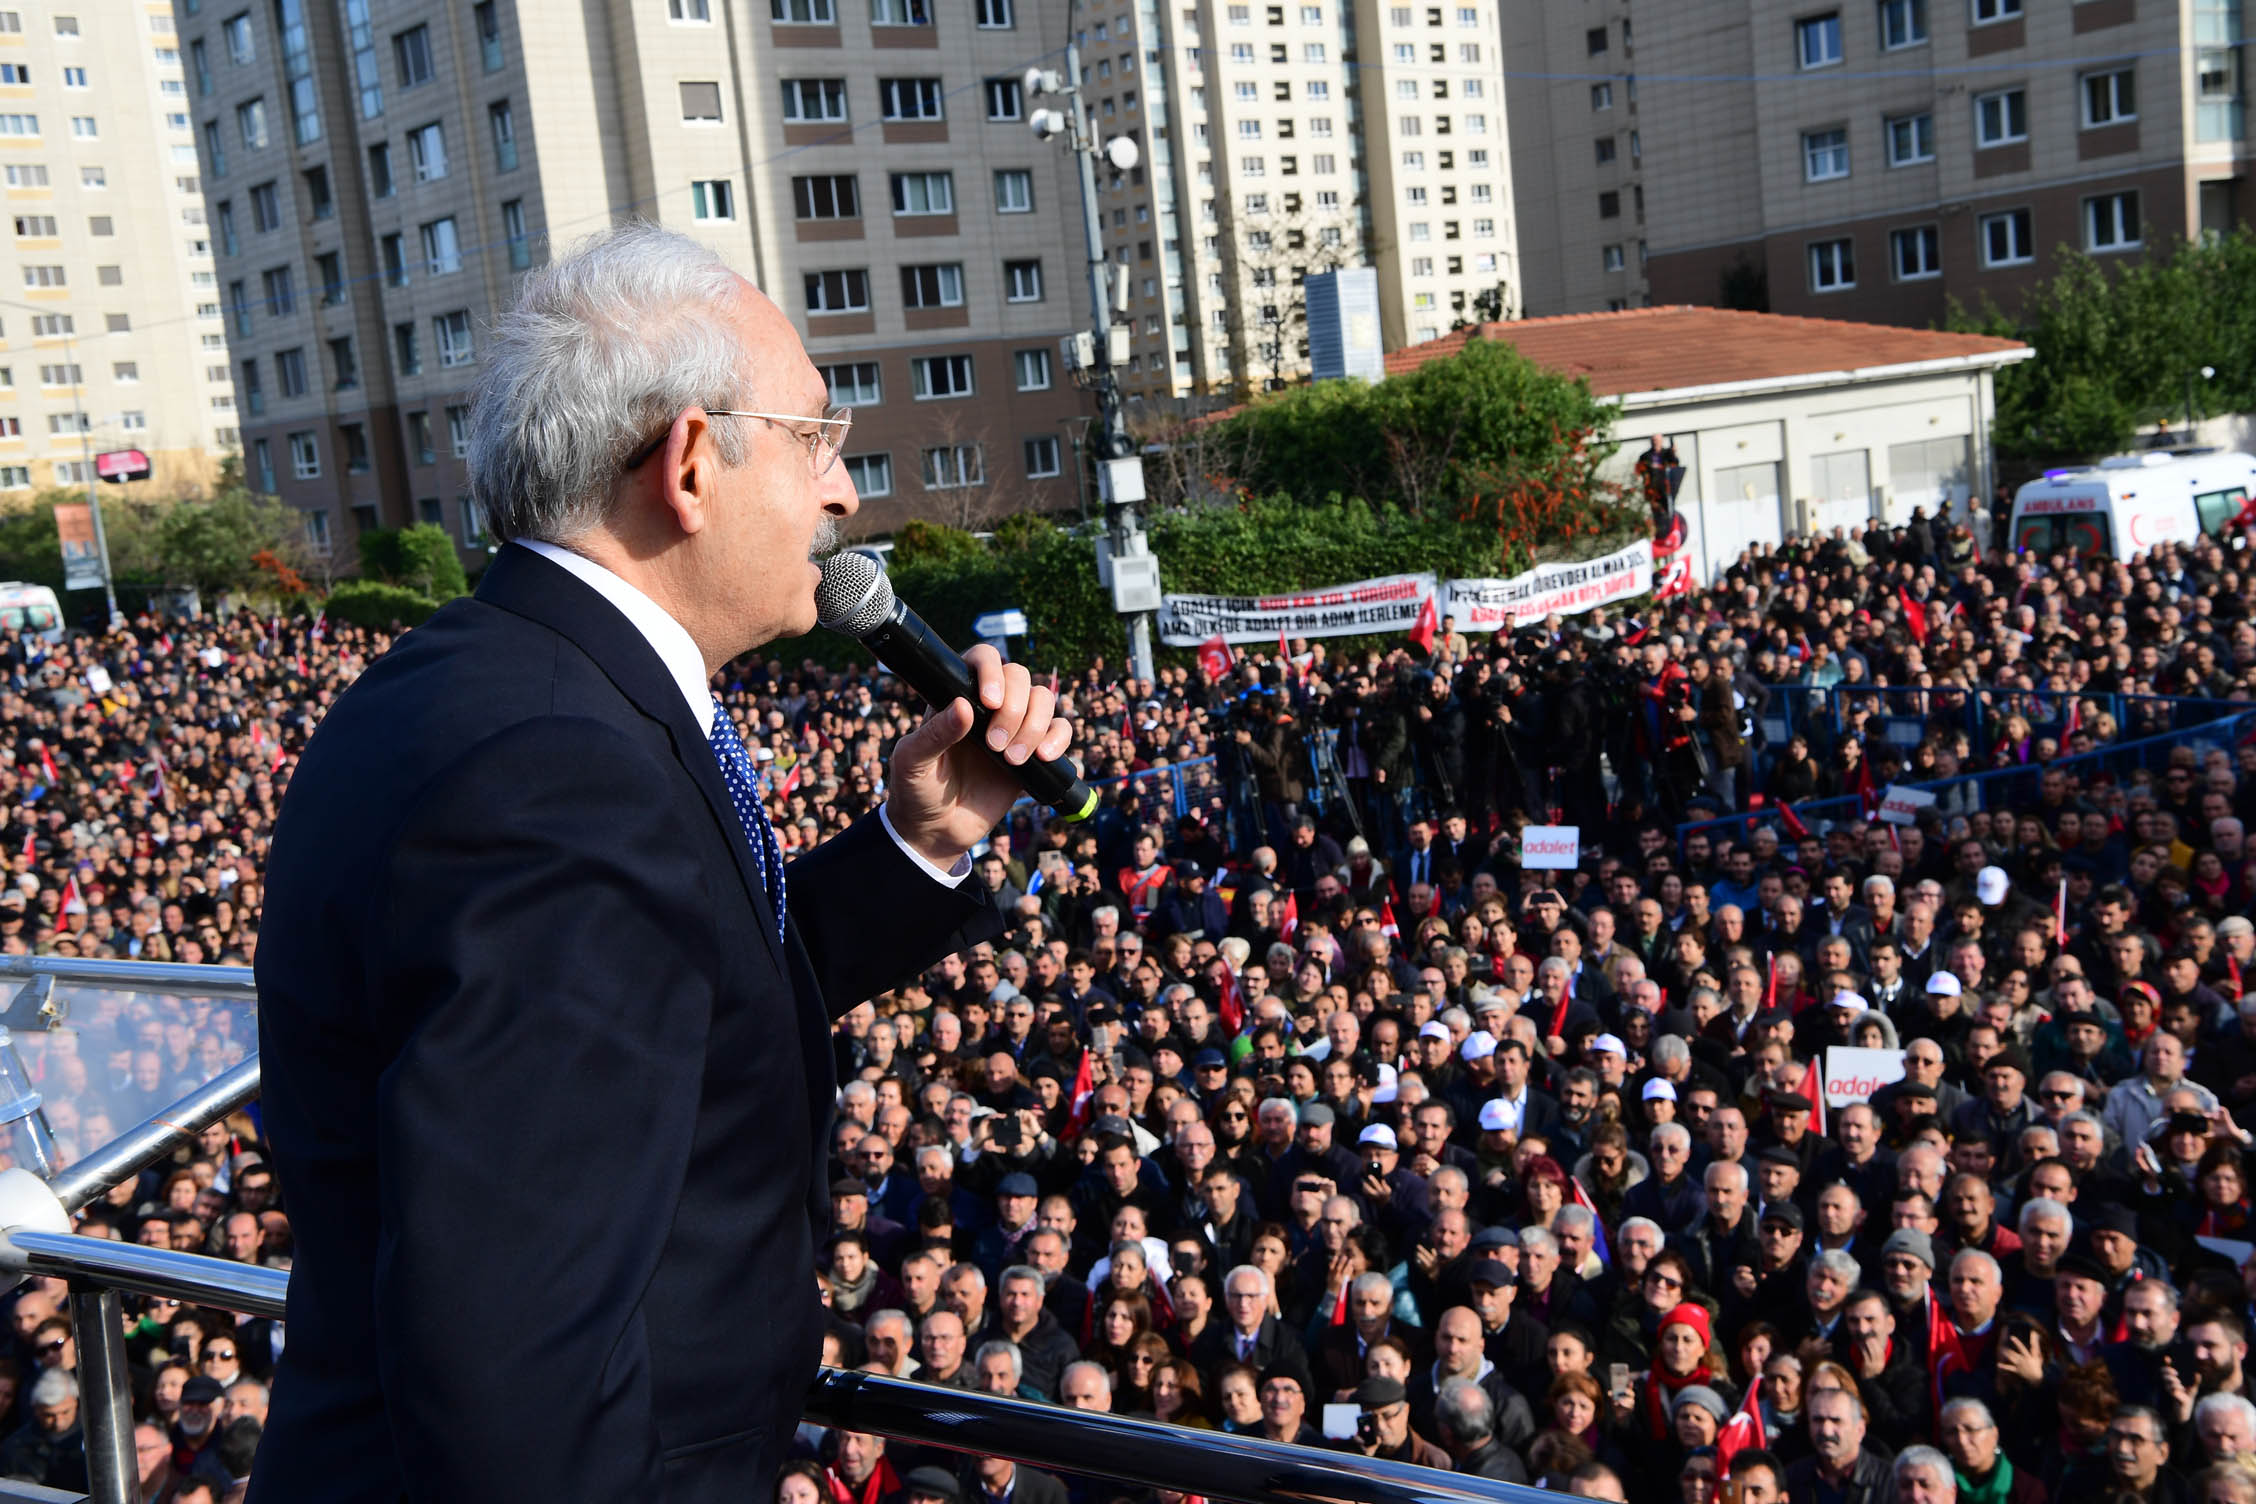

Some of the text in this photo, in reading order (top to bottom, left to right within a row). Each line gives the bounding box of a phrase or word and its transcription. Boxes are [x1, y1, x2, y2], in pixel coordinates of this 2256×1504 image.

[2024, 497, 2096, 513] AMBULANS
[1171, 598, 1221, 617] ADALET
[1320, 591, 1345, 606] YOL
[1349, 578, 1419, 603] YÜRÜDÜK
[1245, 614, 1290, 632] ADALET
[1295, 610, 1318, 630] BİR
[1321, 608, 1356, 628] ADIM
[1523, 839, 1577, 855] adalet
